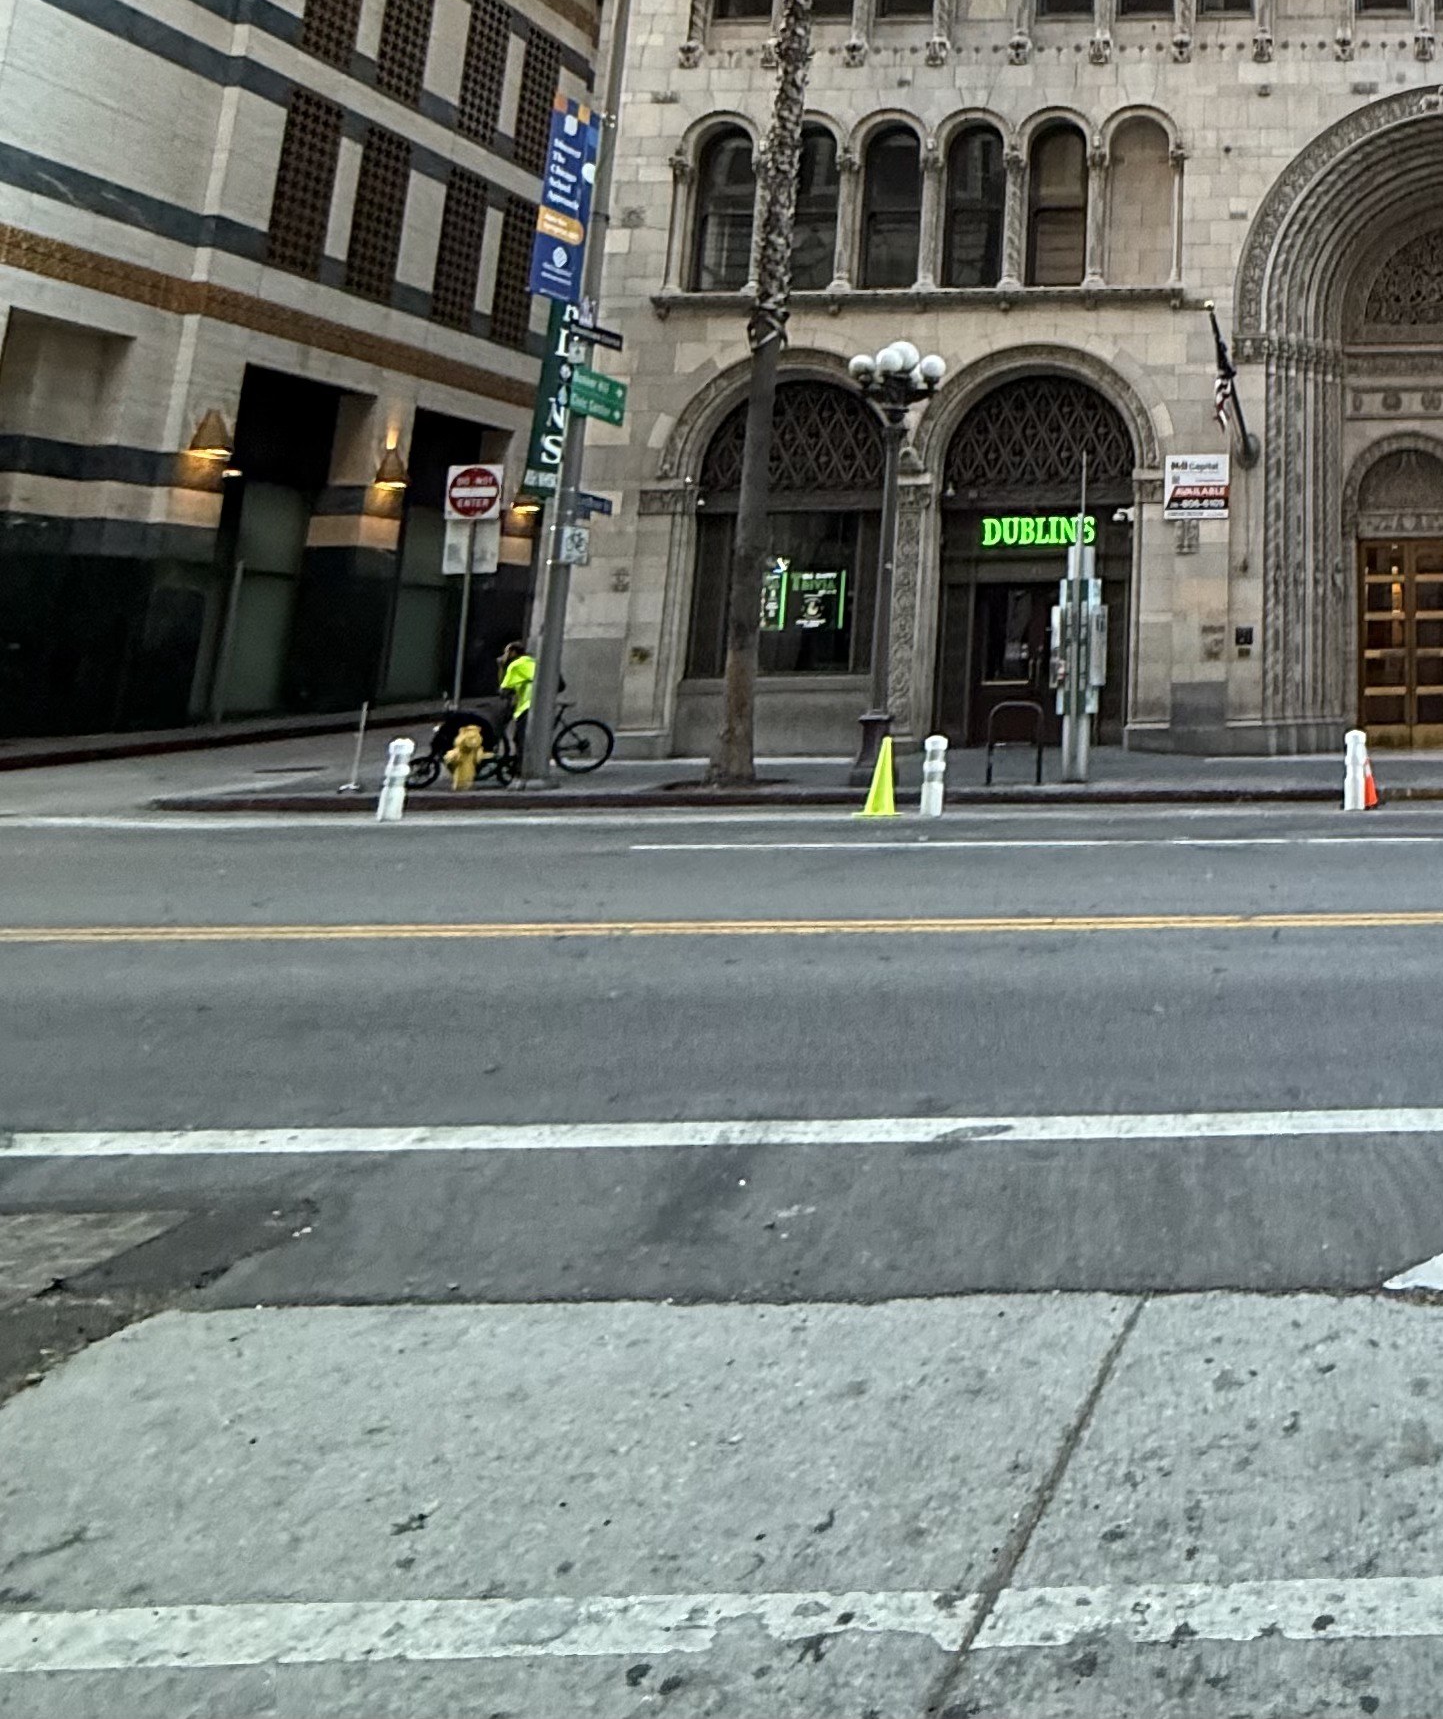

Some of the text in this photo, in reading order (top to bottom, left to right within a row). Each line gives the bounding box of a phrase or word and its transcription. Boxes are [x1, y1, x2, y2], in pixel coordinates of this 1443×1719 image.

[456, 476, 493, 486] DO NOT
[1174, 487, 1225, 496] AVAILABLE
[457, 498, 489, 508] ENTER
[982, 516, 1095, 546] DUBLINS
